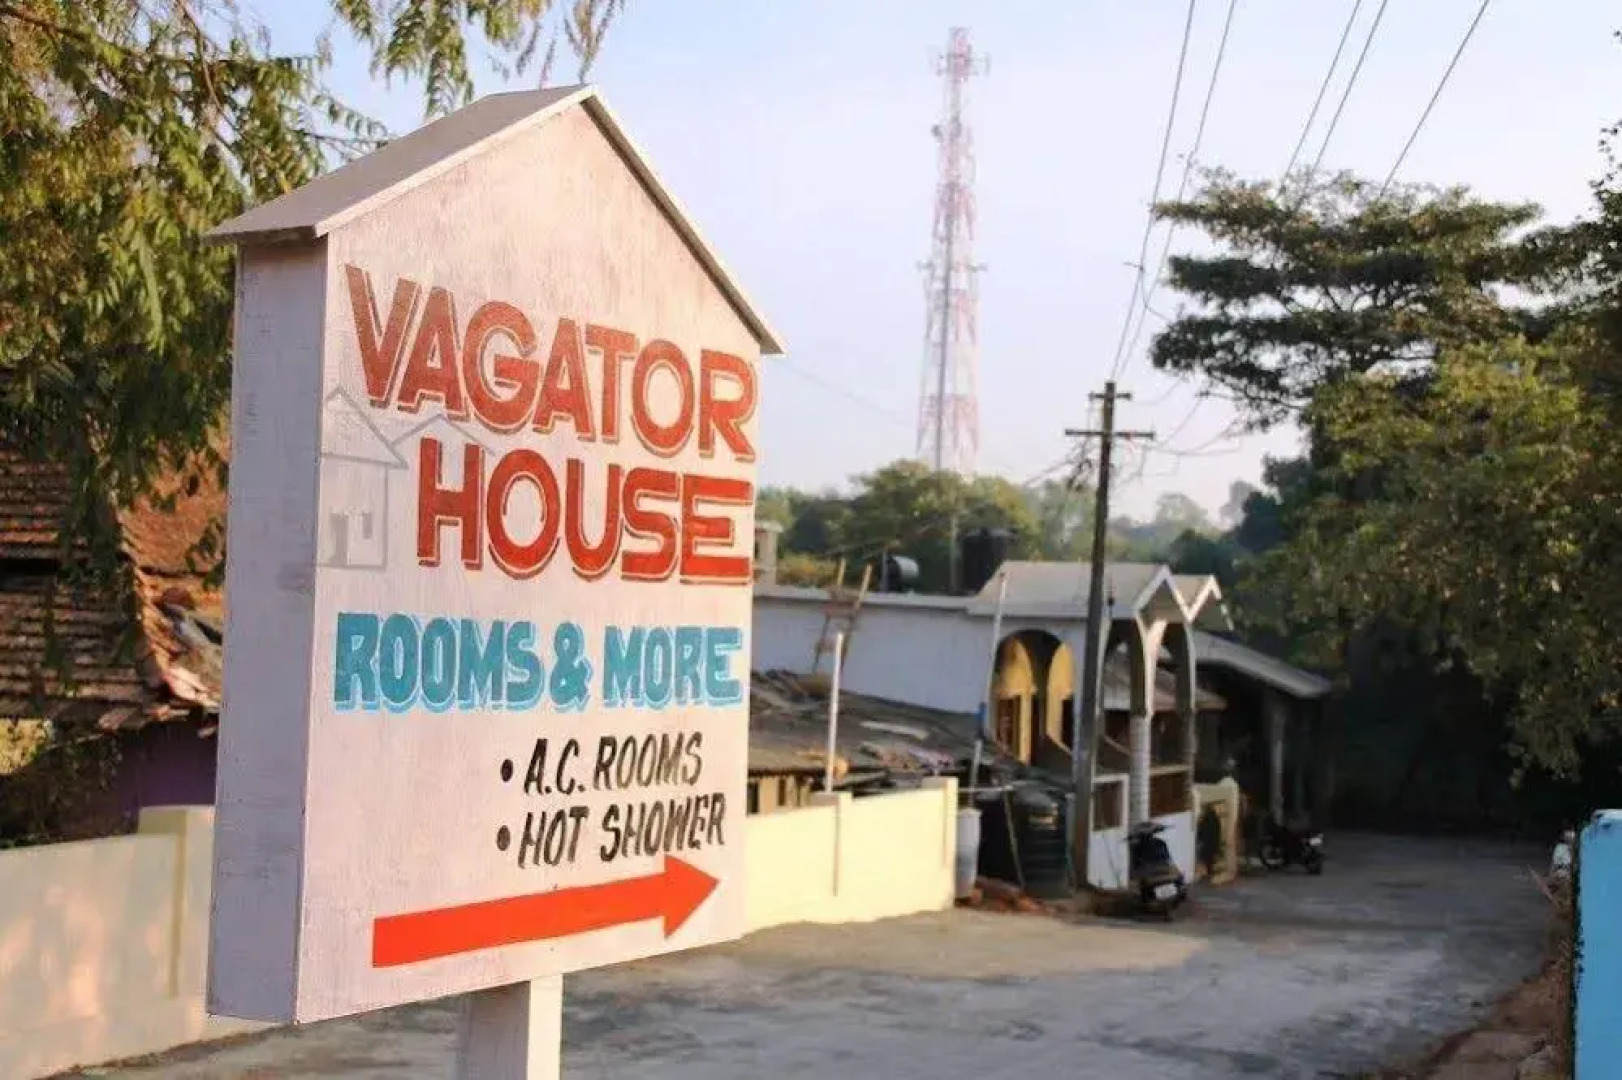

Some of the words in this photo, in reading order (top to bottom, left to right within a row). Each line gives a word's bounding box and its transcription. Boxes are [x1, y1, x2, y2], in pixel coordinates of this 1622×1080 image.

[345, 264, 757, 462] VAGATOR
[417, 436, 753, 584] HOUSE
[333, 612, 546, 713] ROOMS
[550, 621, 593, 713] &
[603, 625, 745, 709] MORE
[524, 738, 585, 794] A.C.
[594, 732, 703, 790] ROOMS
[518, 806, 590, 868] HOT
[600, 793, 725, 862] SHOWER
